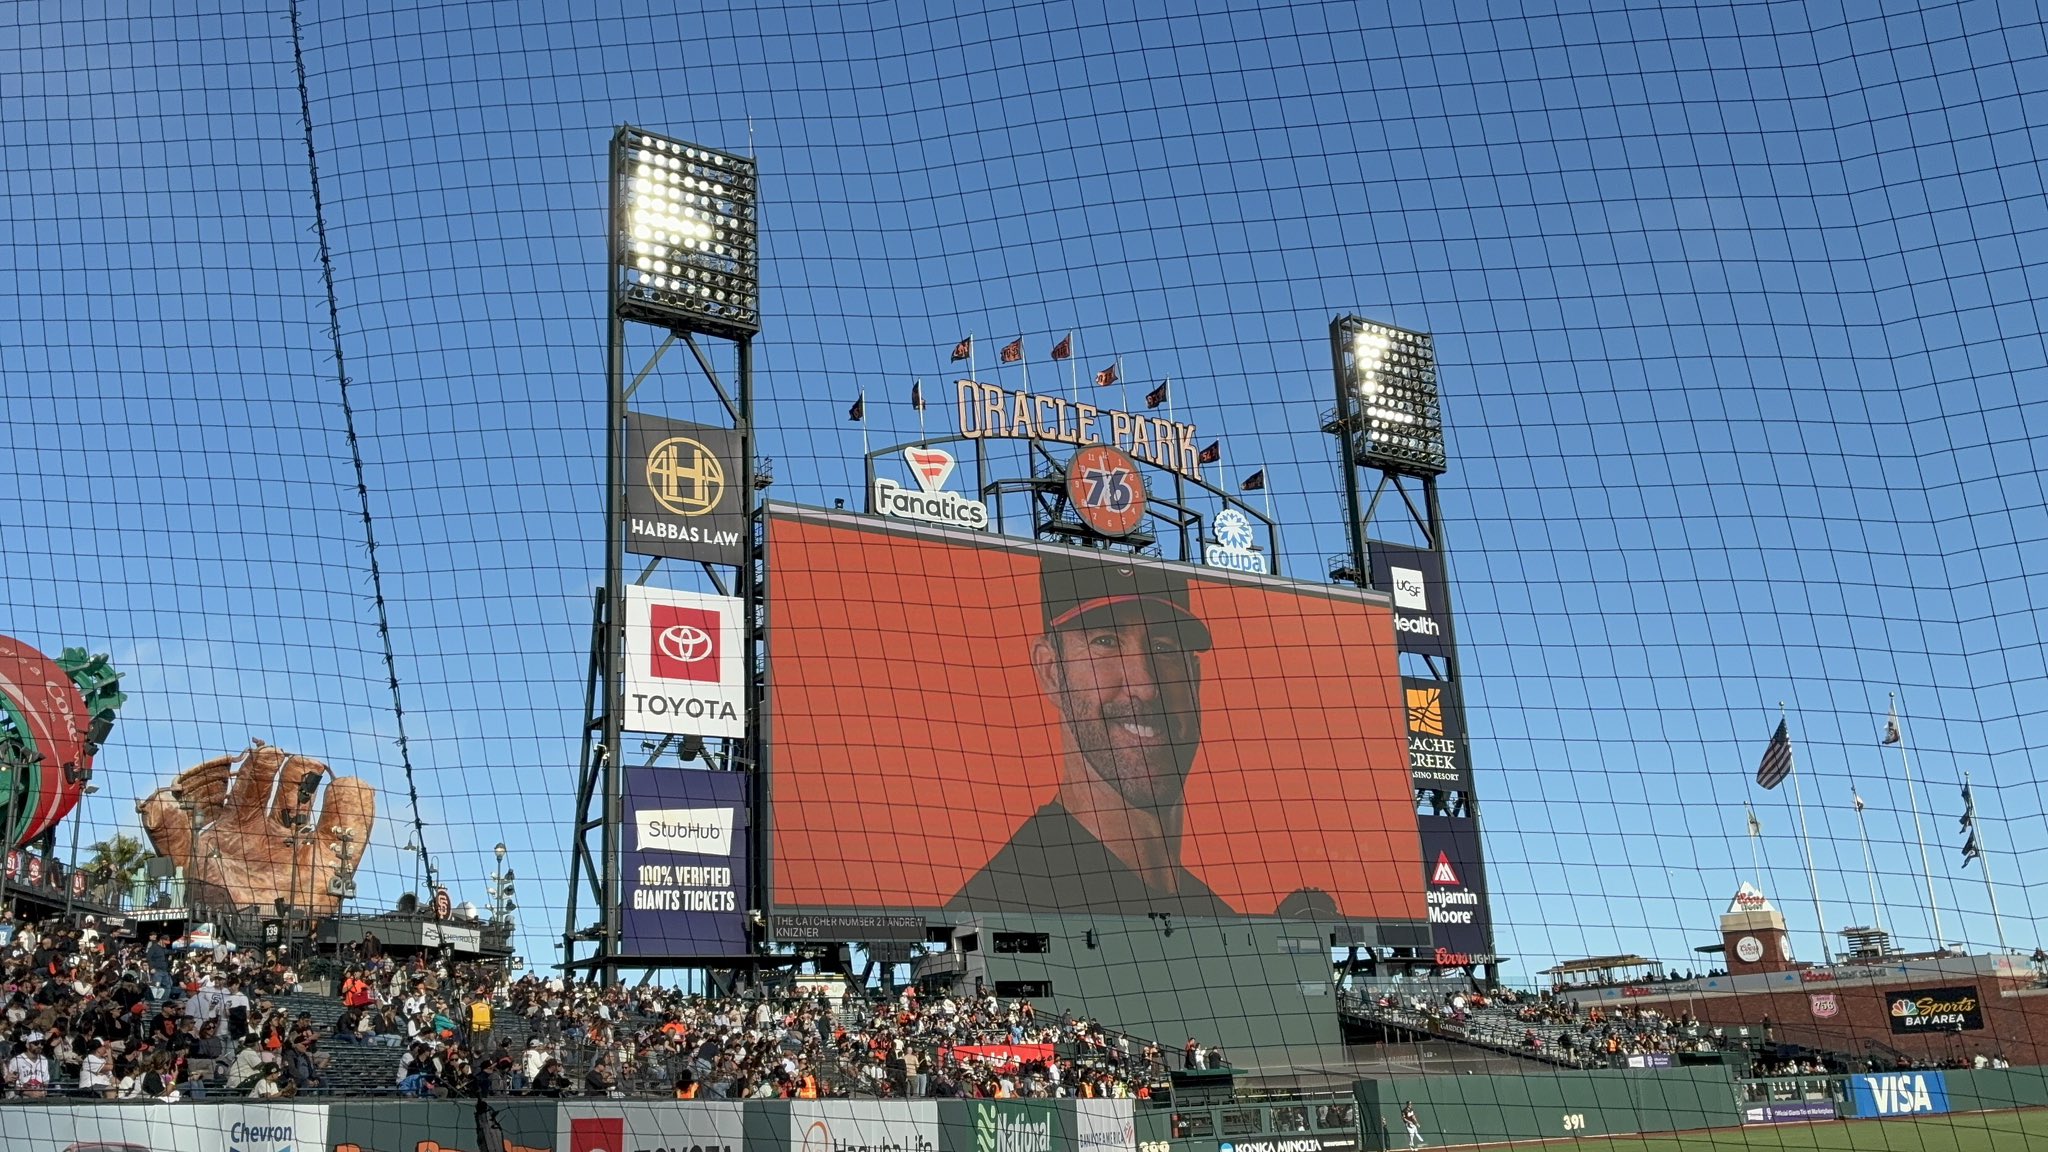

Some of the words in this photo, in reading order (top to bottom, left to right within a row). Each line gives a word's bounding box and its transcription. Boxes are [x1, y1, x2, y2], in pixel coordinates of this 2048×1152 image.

[957, 378, 1099, 445] ORACLE
[1109, 409, 1202, 481] PARK
[1083, 467, 1133, 513] 76
[880, 484, 983, 523] Fanatics
[631, 518, 699, 543] HABBAS
[703, 527, 739, 547] LAW
[1209, 549, 1263, 573] coupa
[1396, 578, 1421, 597] UCSF
[46, 681, 78, 742] Coke
[632, 694, 737, 720] TOYOTA
[1433, 771, 1459, 781] RESORT
[649, 821, 720, 839] StubHub
[638, 865, 673, 886] 100%
[675, 866, 731, 887] VERIFIED
[634, 890, 680, 910] GIANTS
[683, 891, 735, 911] TICKETS
[1426, 887, 1478, 908] enjamin
[777, 916, 793, 926] THE
[796, 917, 837, 926] CATCHER
[839, 917, 875, 927] NUMBER
[877, 918, 885, 927] 21
[887, 918, 923, 927] ANDREW
[1428, 906, 1471, 923] Moore
[266, 925, 278, 936] 139
[776, 927, 819, 937] KNIZNER
[1435, 947, 1469, 965] Coors
[1469, 953, 1496, 965] LIGHT
[1815, 1001, 1834, 1011] 756
[1916, 997, 1976, 1017] Sports
[1905, 1015, 1928, 1026] BAY
[1932, 1013, 1964, 1024] AREA
[1864, 1075, 1932, 1113] VISA
[231, 1121, 292, 1143] Chevron
[997, 1111, 1050, 1152] National
[1563, 1114, 1585, 1130] 391
[1235, 1141, 1275, 1152] KONICA
[1277, 1139, 1322, 1152] MINOLTA
